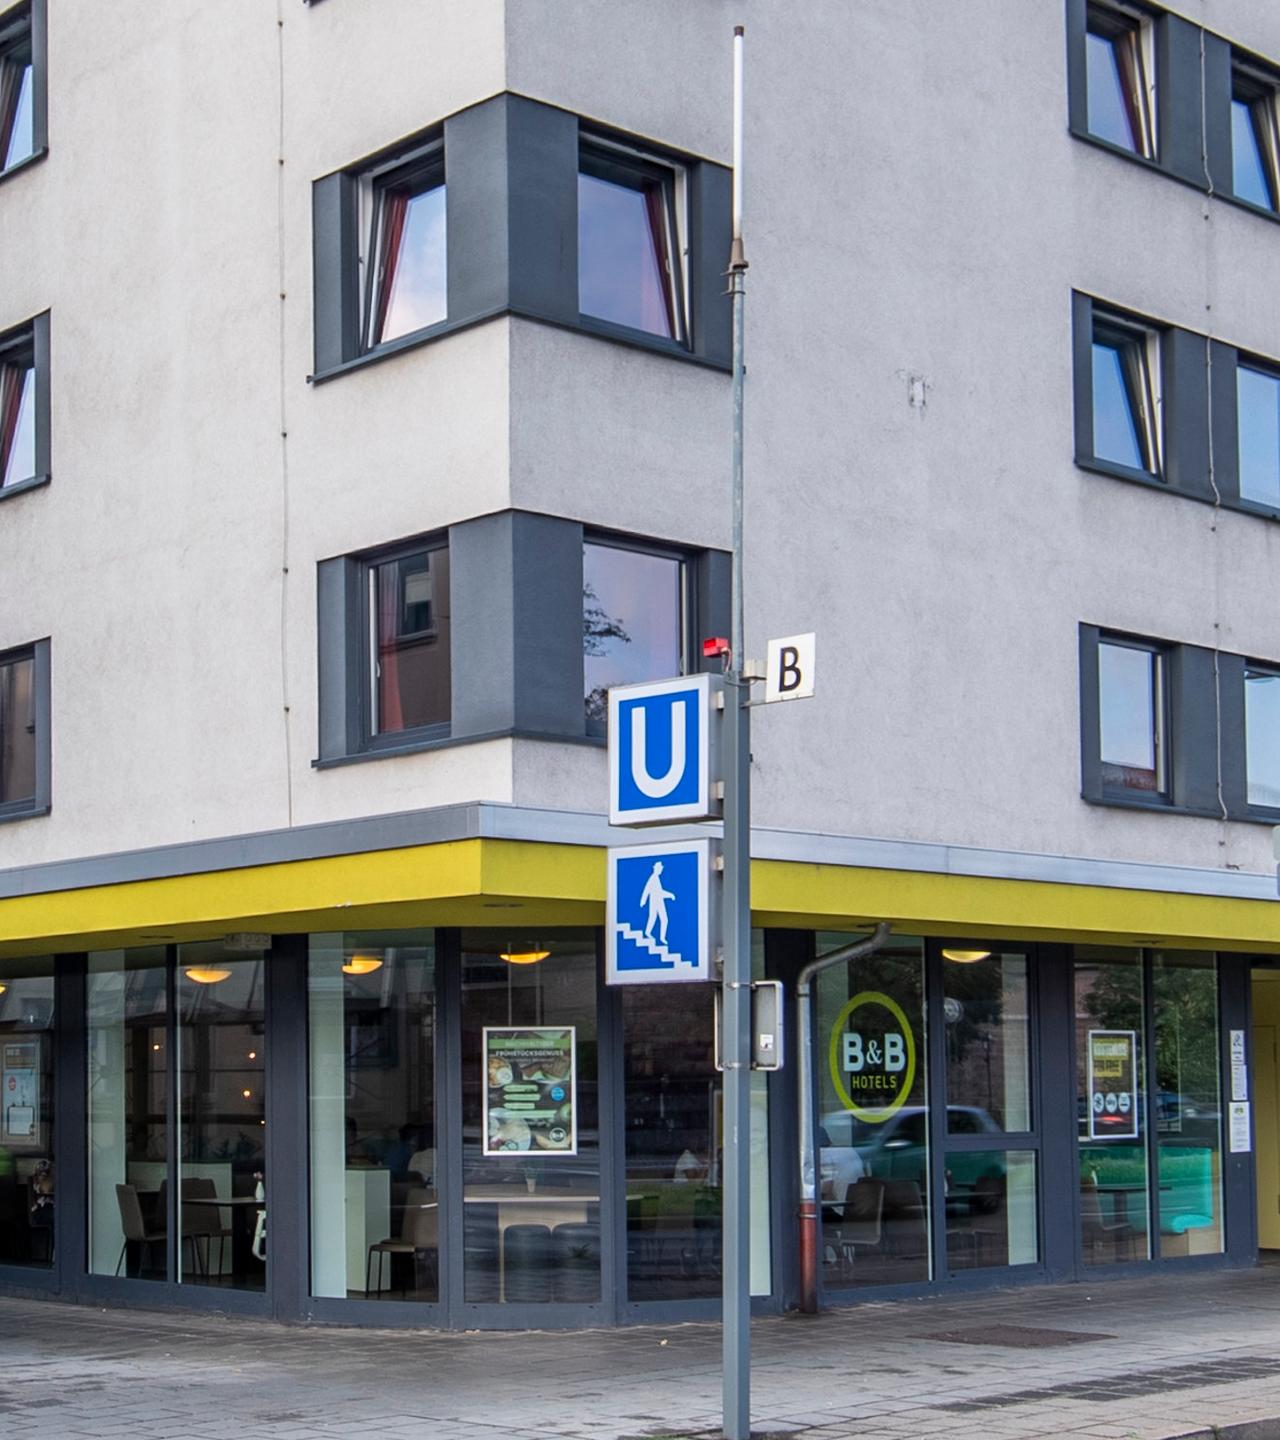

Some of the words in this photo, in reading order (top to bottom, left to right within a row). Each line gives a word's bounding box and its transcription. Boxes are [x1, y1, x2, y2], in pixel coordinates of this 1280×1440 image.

[779, 646, 802, 693] B
[631, 700, 686, 799] U
[843, 1032, 906, 1072] B&B
[852, 1075, 897, 1089] HOTELS
